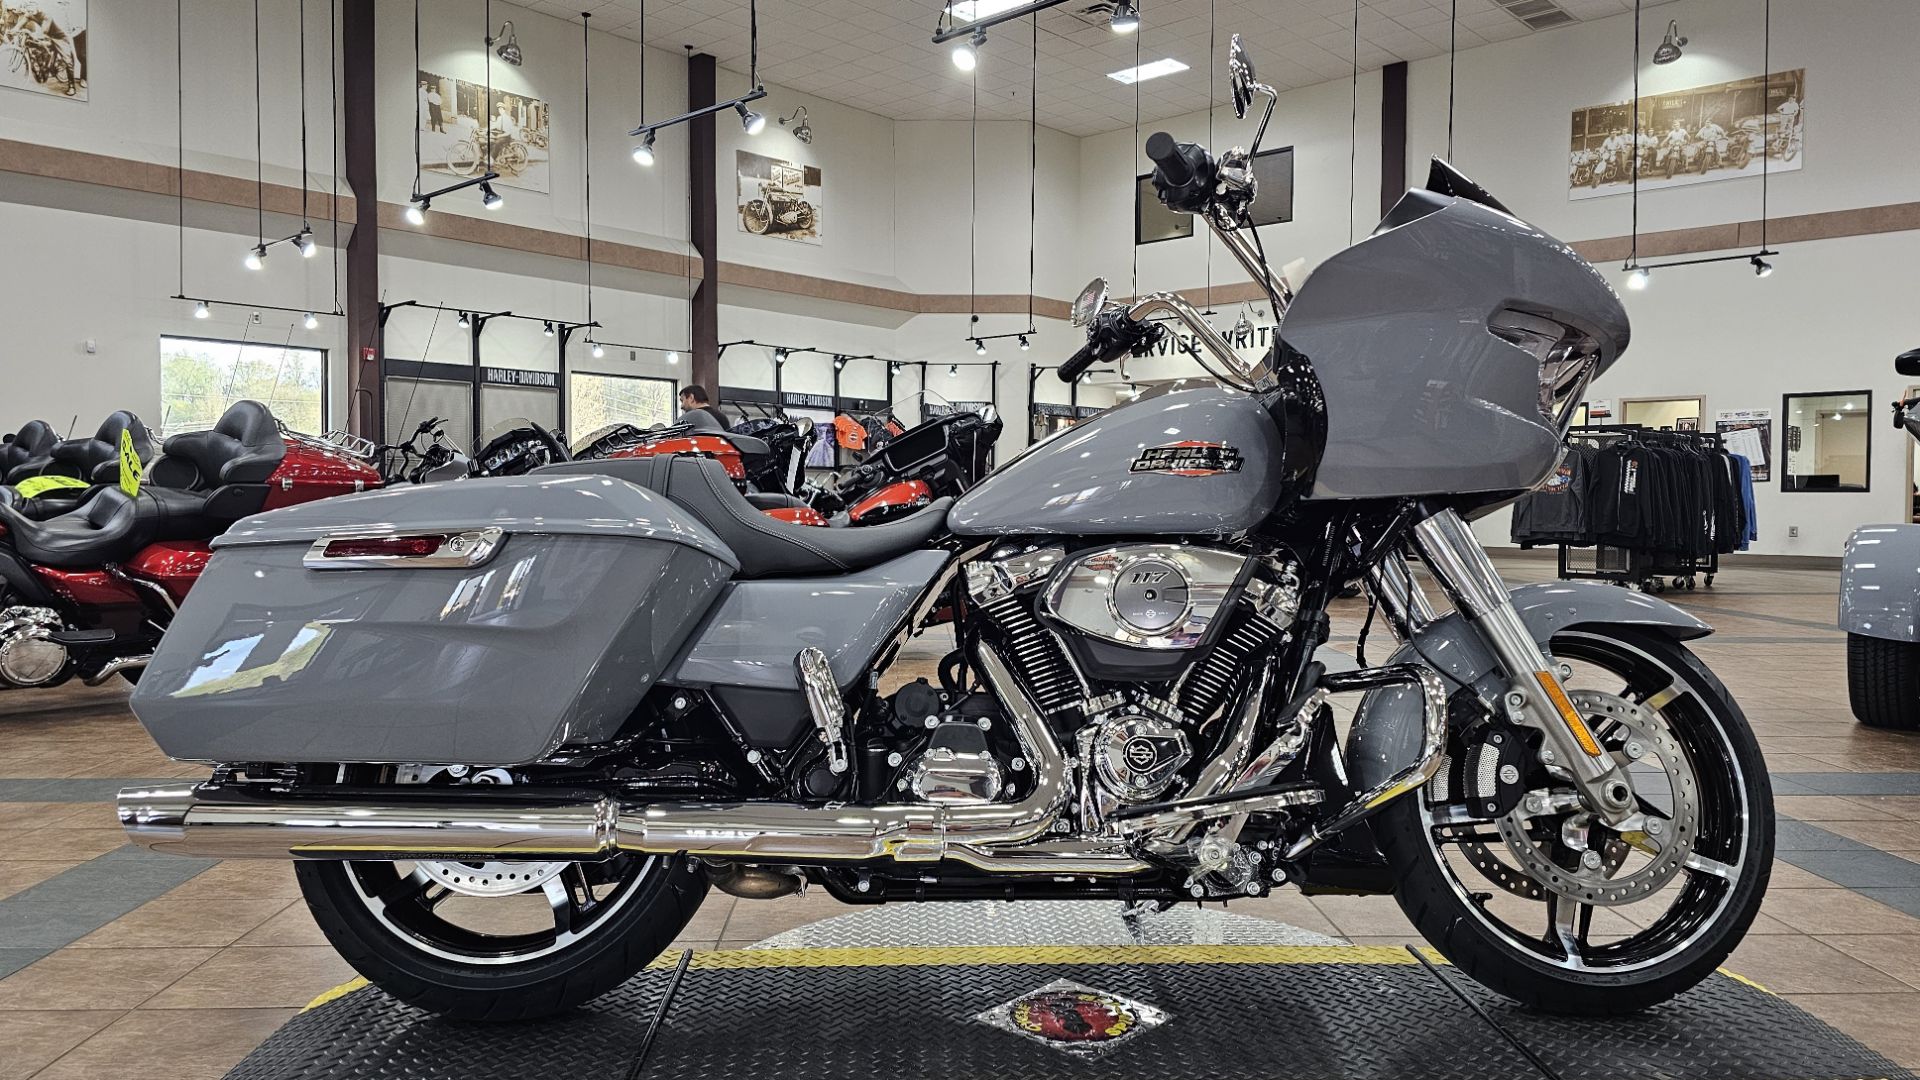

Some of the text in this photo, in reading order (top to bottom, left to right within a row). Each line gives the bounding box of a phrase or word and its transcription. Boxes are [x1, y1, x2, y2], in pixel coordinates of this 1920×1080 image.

[1132, 334, 1202, 358] RVICE
[487, 368, 555, 387] HARLEY-DAVIDSON
[1130, 570, 1171, 585] 117
